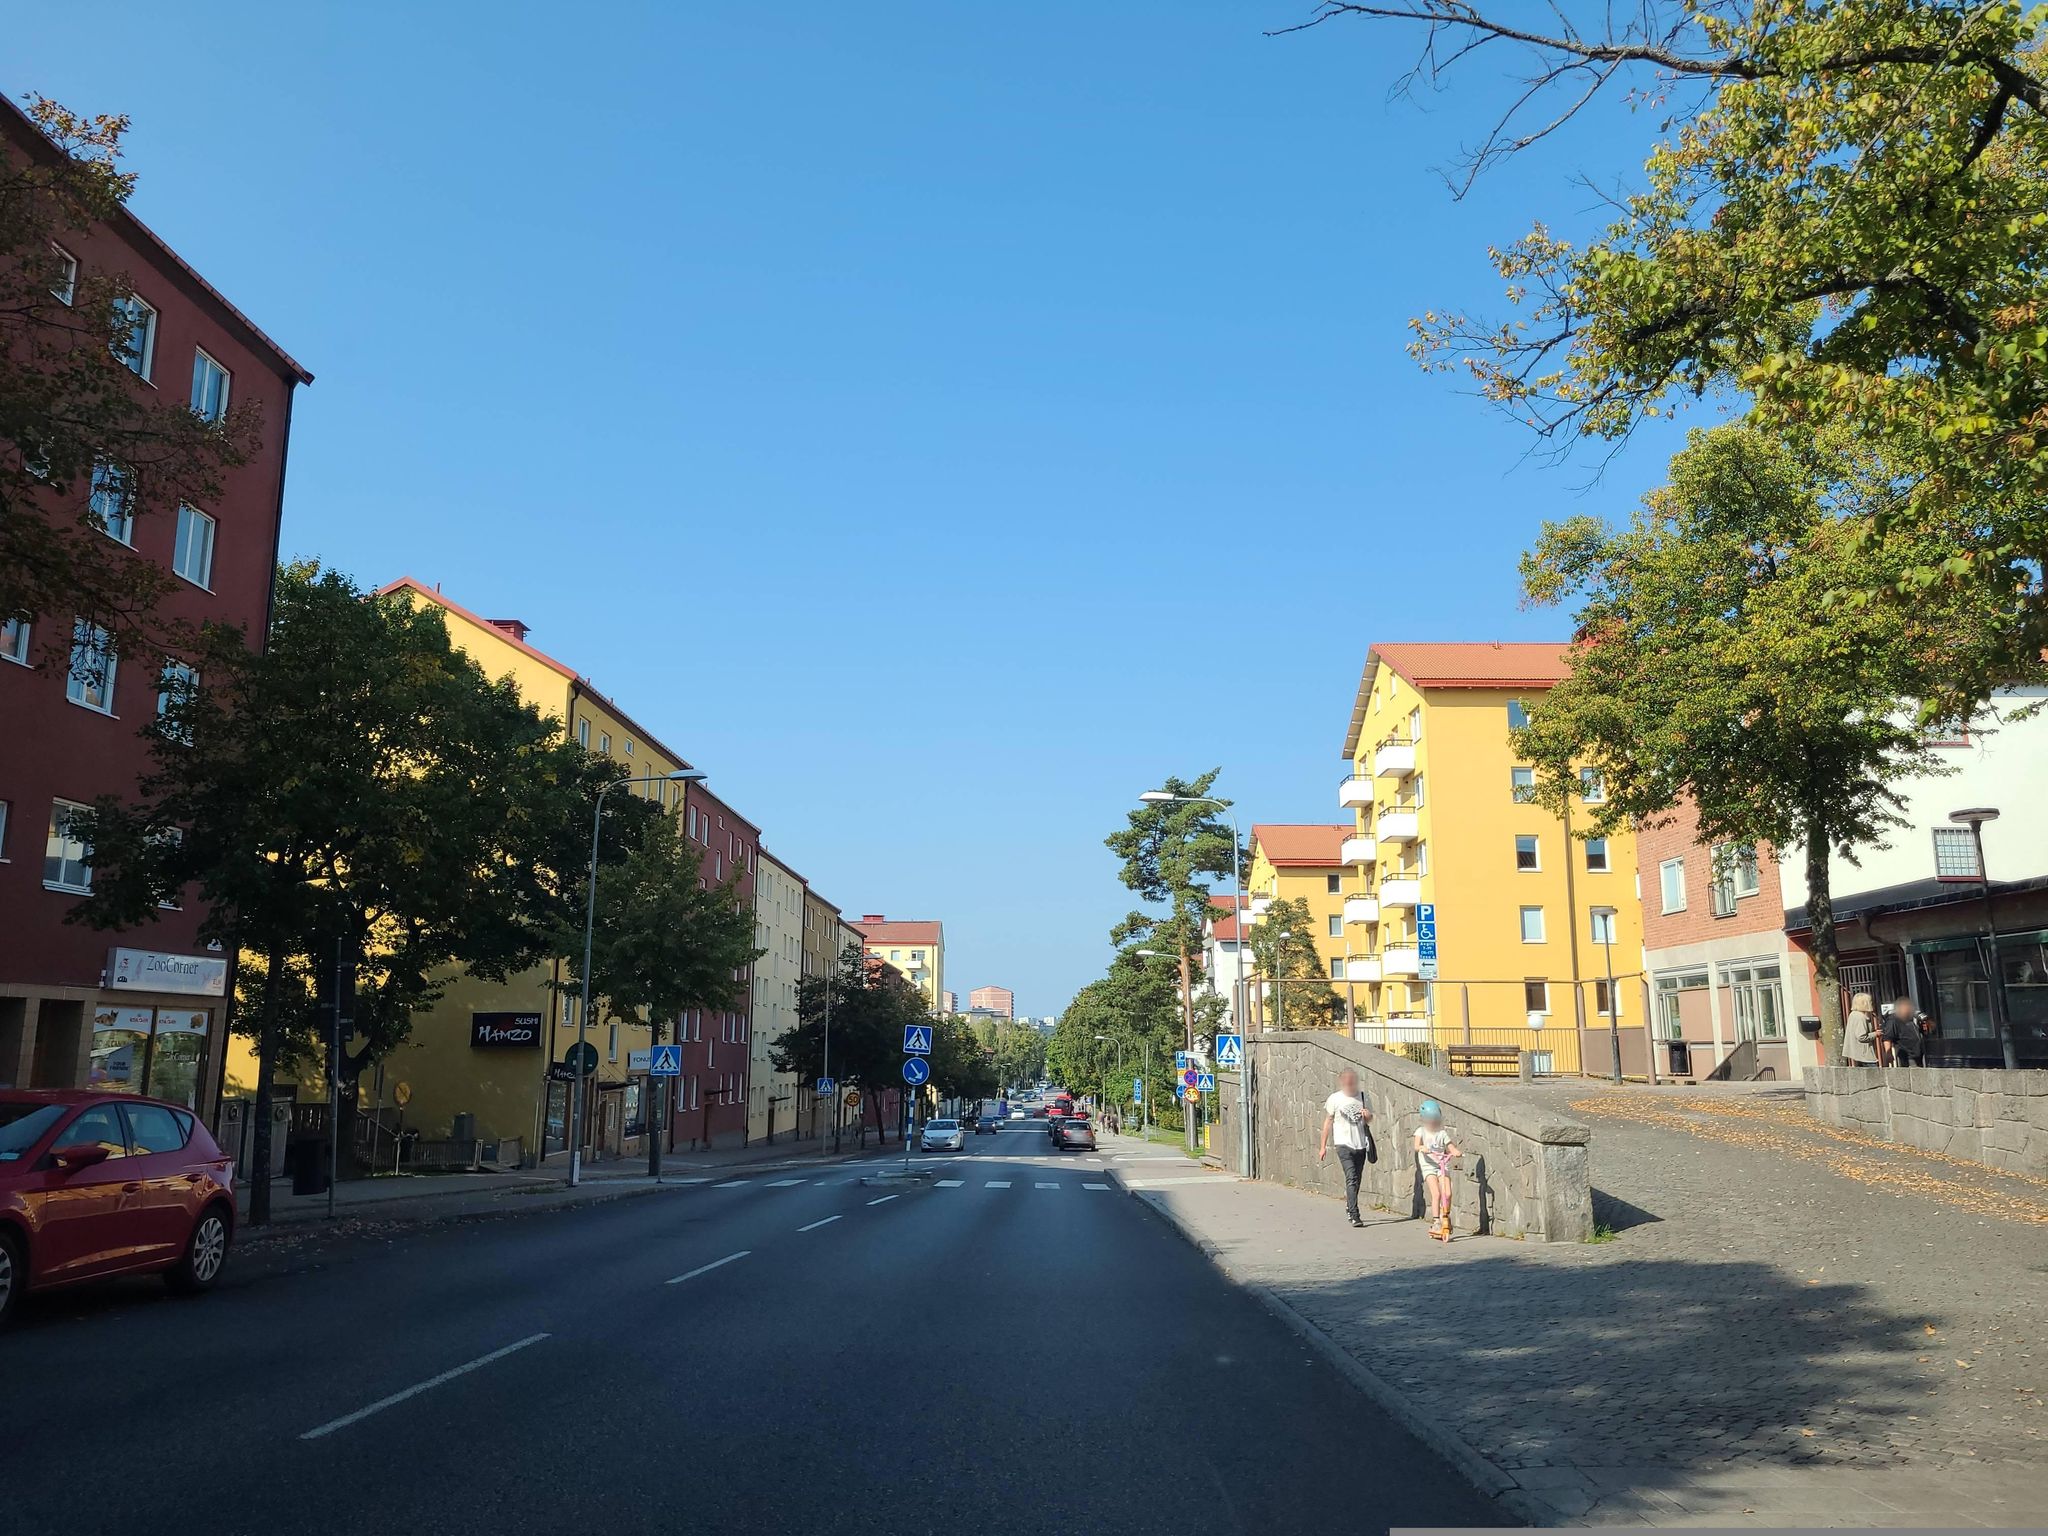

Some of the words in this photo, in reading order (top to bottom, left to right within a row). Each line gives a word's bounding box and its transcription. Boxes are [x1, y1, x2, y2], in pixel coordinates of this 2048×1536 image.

[1421, 905, 1431, 920] P
[146, 955, 199, 975] ZooCorner
[514, 1017, 538, 1025] SUSHI
[478, 1025, 532, 1042] HAMZO
